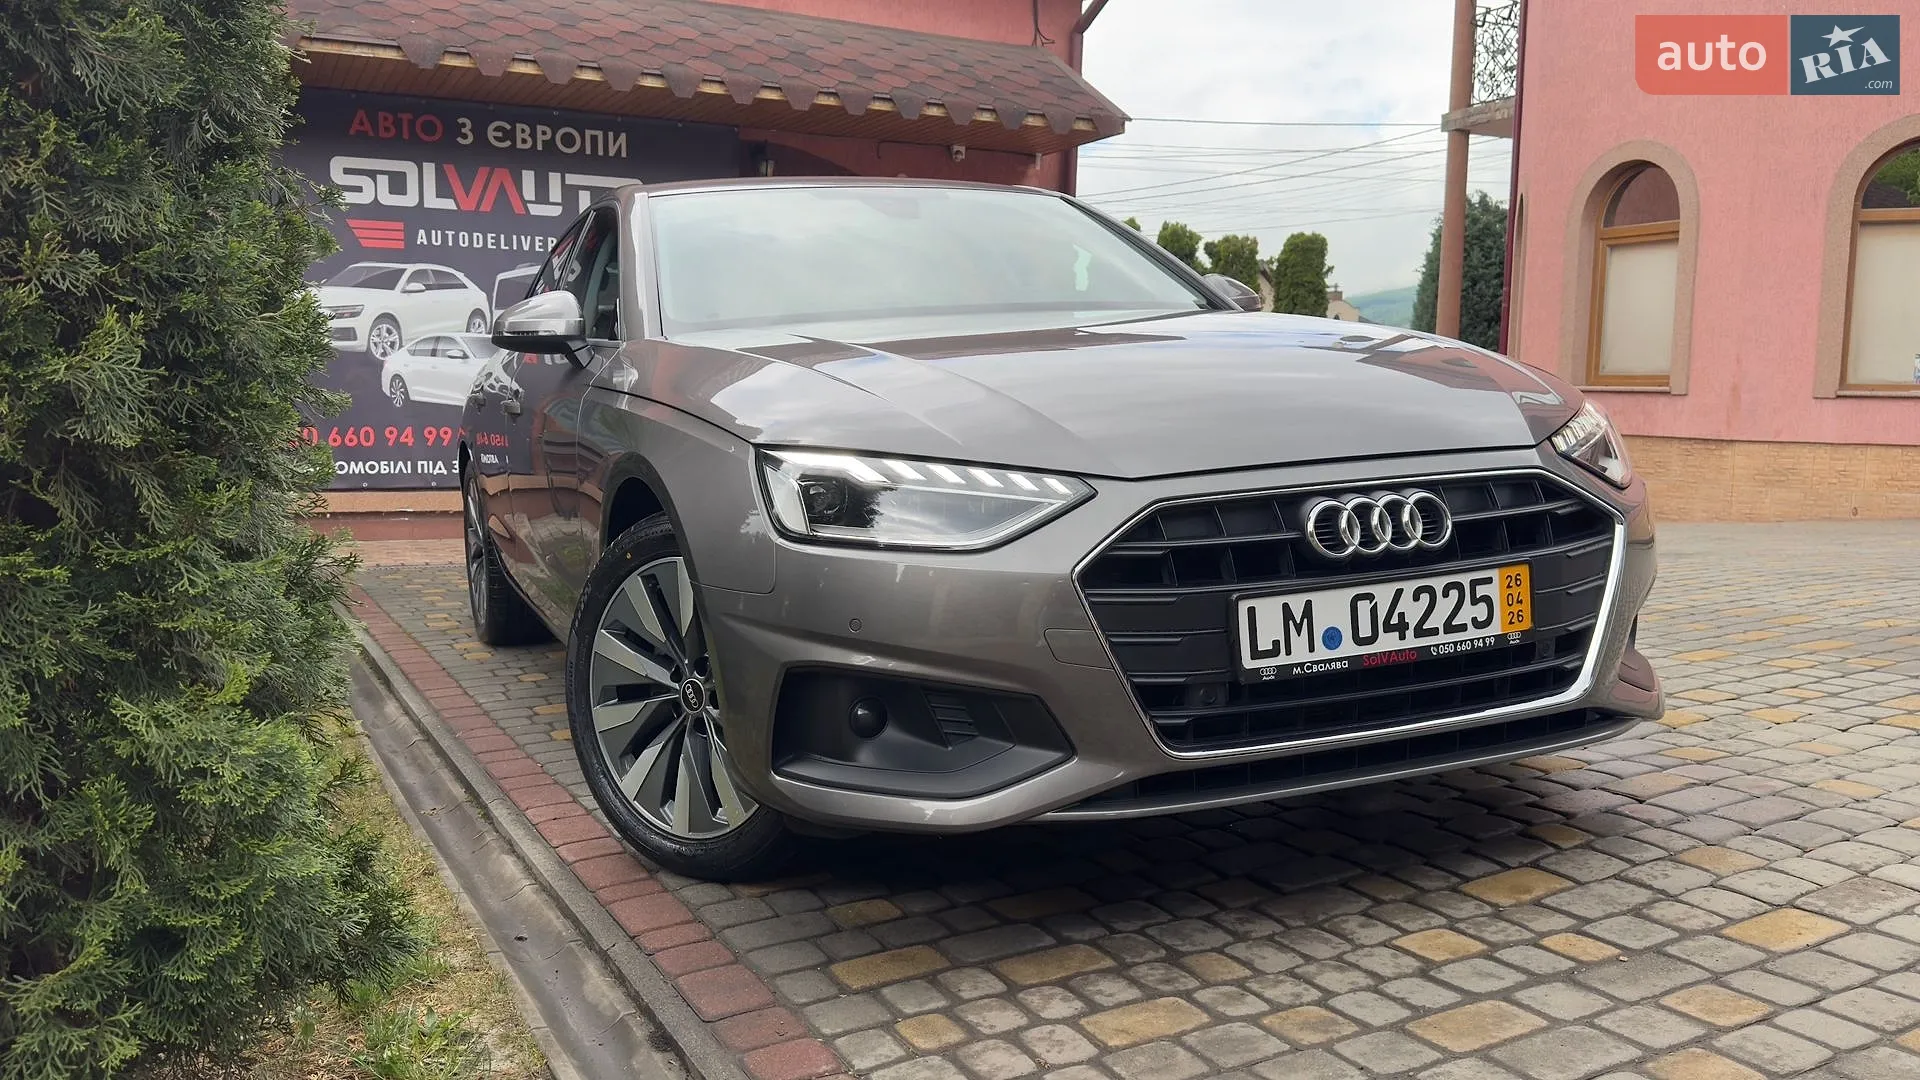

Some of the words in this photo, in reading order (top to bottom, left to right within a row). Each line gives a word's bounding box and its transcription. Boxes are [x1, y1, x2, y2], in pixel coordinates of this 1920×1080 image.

[350, 109, 443, 142] АВТО
[487, 121, 628, 158] ЄВРОПИ
[329, 155, 643, 217] SOLVAUT
[328, 426, 375, 447] 660
[384, 426, 414, 447] 94
[423, 426, 453, 447] 99
[417, 460, 448, 475] ПІД
[1505, 573, 1522, 589] 26
[1506, 592, 1523, 607] 04
[1247, 599, 1315, 660] LM
[1350, 576, 1494, 647] 04225
[1507, 609, 1525, 625] 26
[1439, 642, 1454, 655] 050
[1456, 641, 1472, 652] 660
[1473, 638, 1484, 649] 94
[1485, 636, 1495, 646] 99
